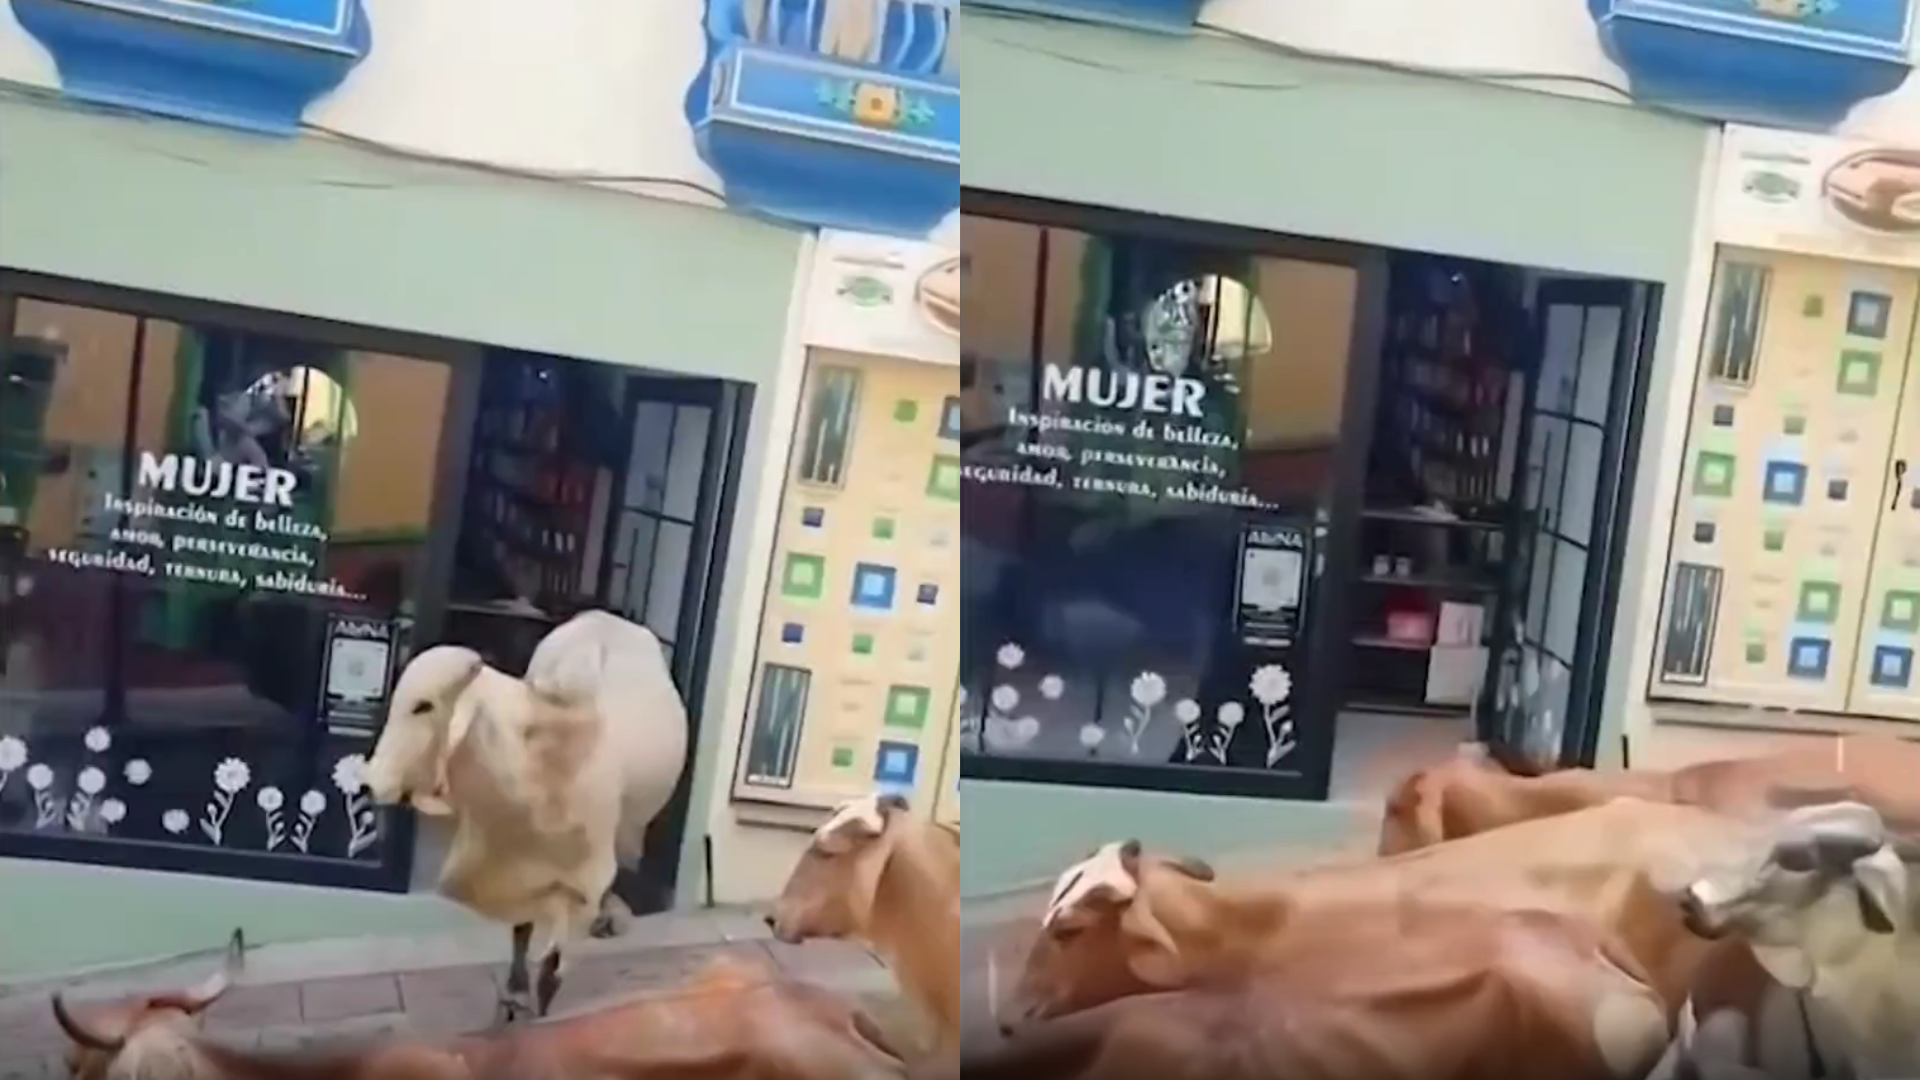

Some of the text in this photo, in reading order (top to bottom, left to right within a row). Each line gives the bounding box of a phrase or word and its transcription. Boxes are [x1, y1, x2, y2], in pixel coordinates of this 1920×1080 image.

[1043, 363, 1207, 418] MUJER
[1132, 419, 1155, 440] de
[138, 452, 297, 507] MUJER
[225, 508, 246, 530] de
